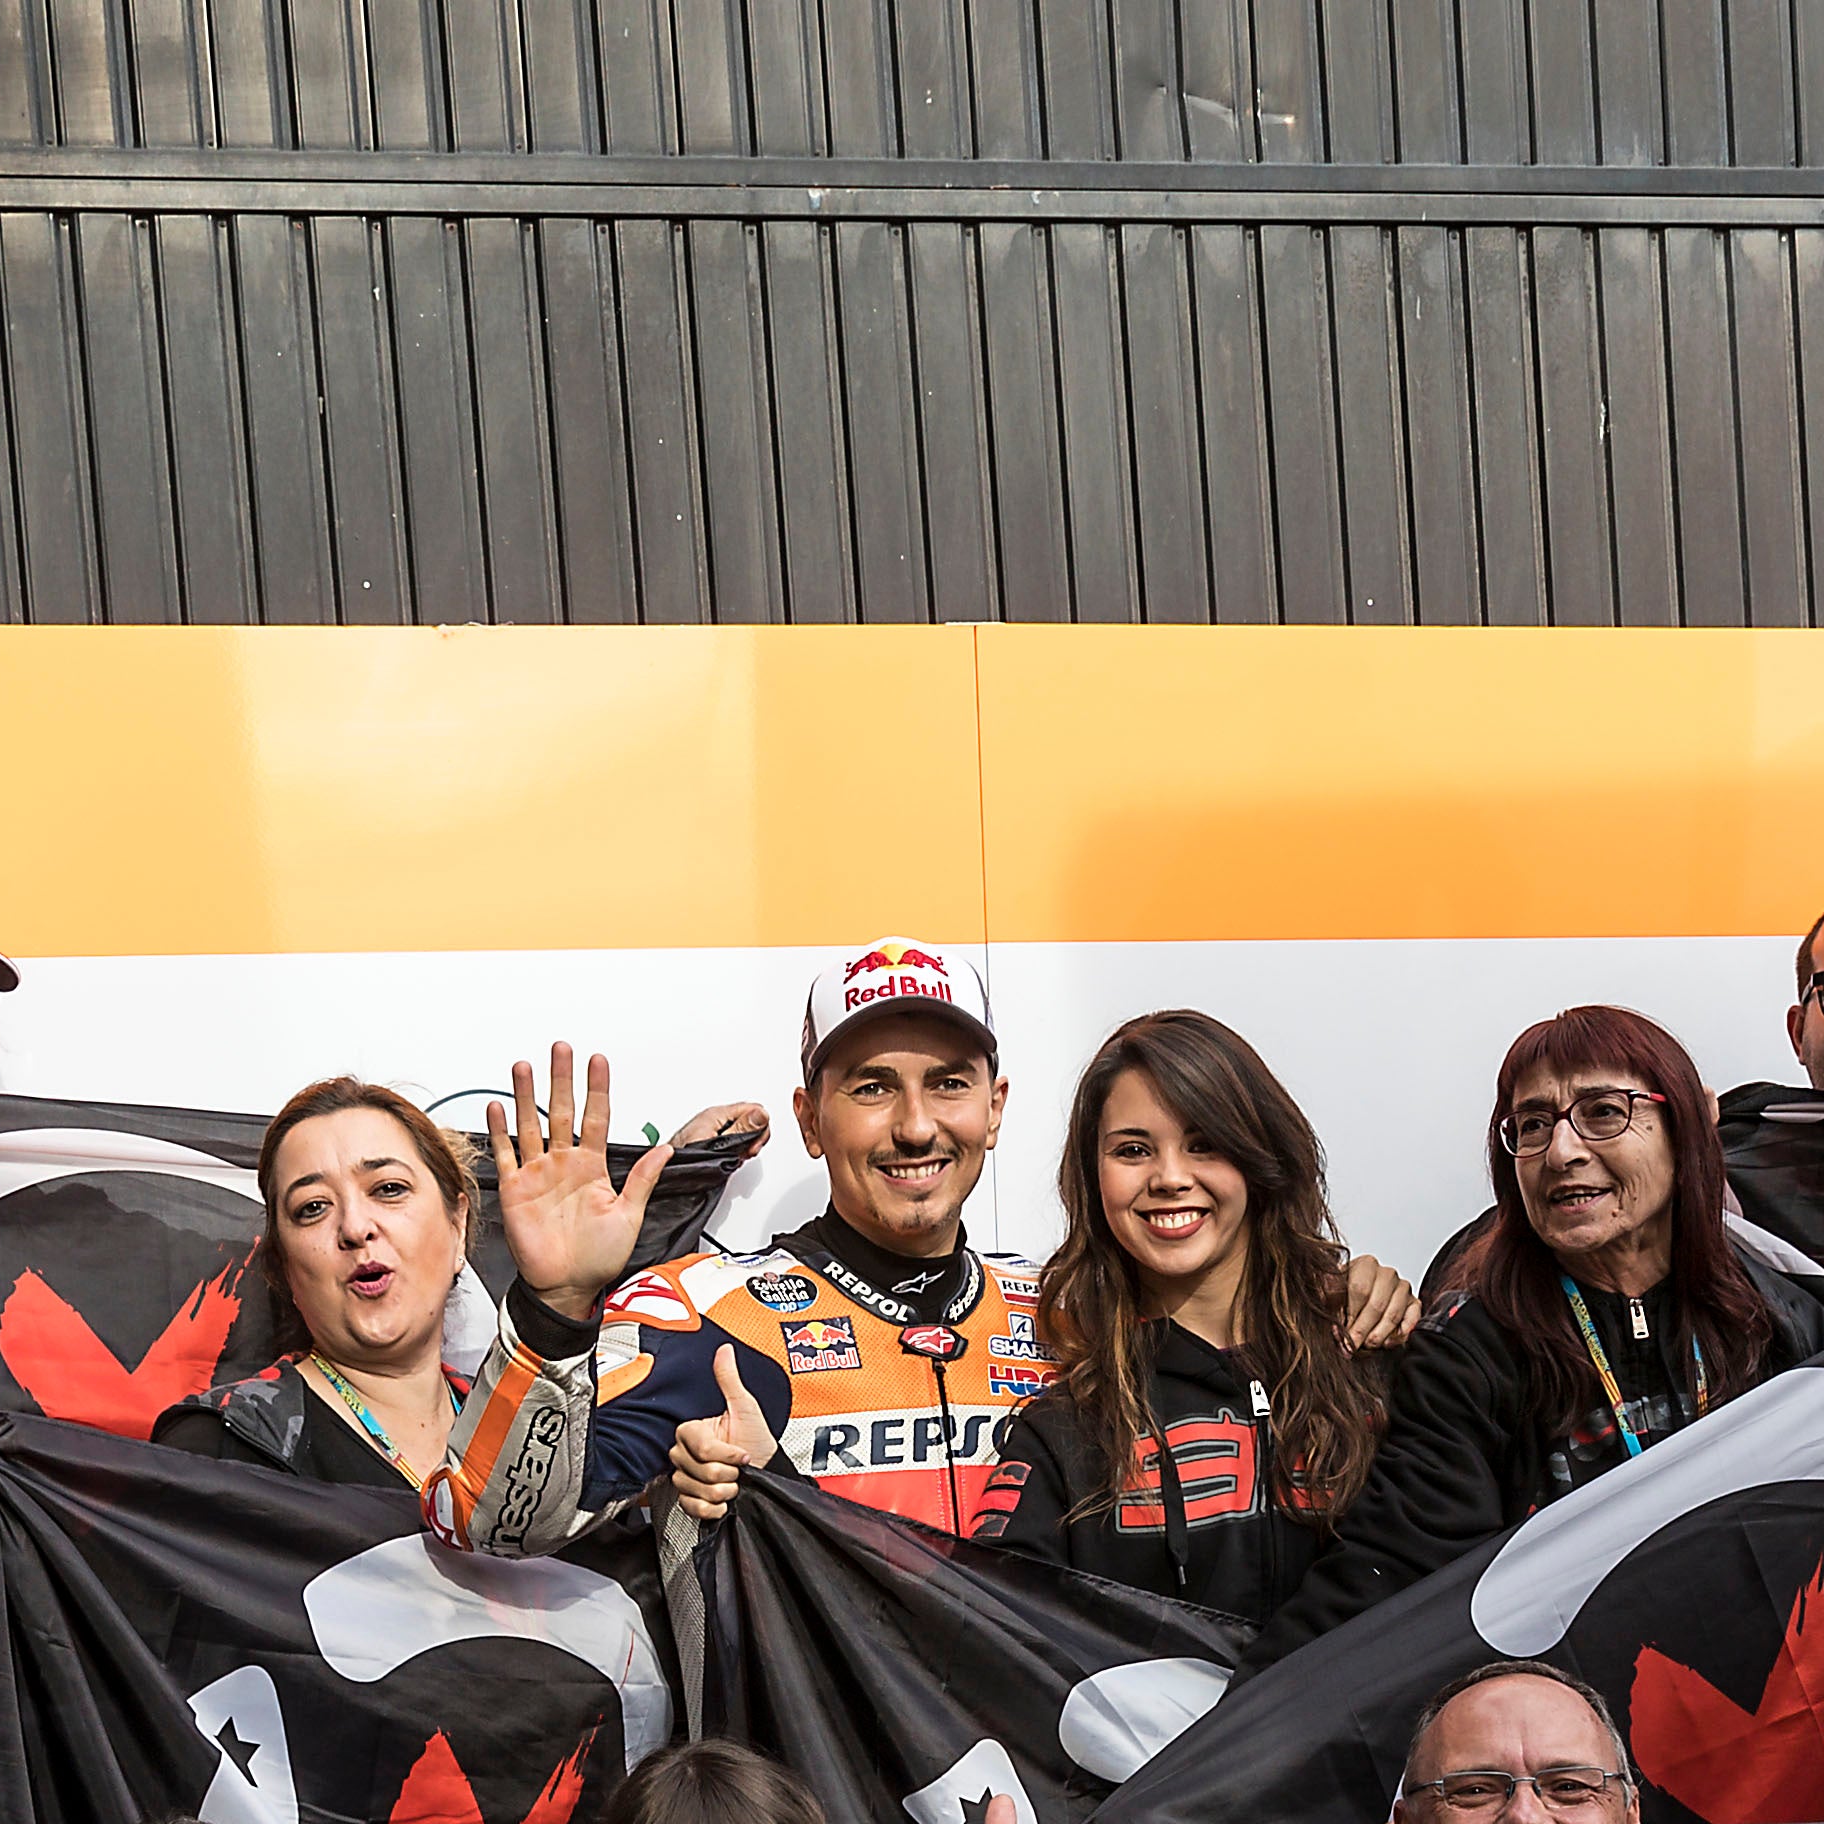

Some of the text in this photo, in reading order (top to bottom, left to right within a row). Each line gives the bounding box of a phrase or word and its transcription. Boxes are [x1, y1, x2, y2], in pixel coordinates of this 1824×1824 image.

[845, 976, 952, 1012] Red Bull
[752, 1278, 806, 1292] Estrella
[760, 1287, 810, 1303] Galicia
[822, 1261, 908, 1322] REPSOL
[791, 1350, 860, 1371] Red Bull
